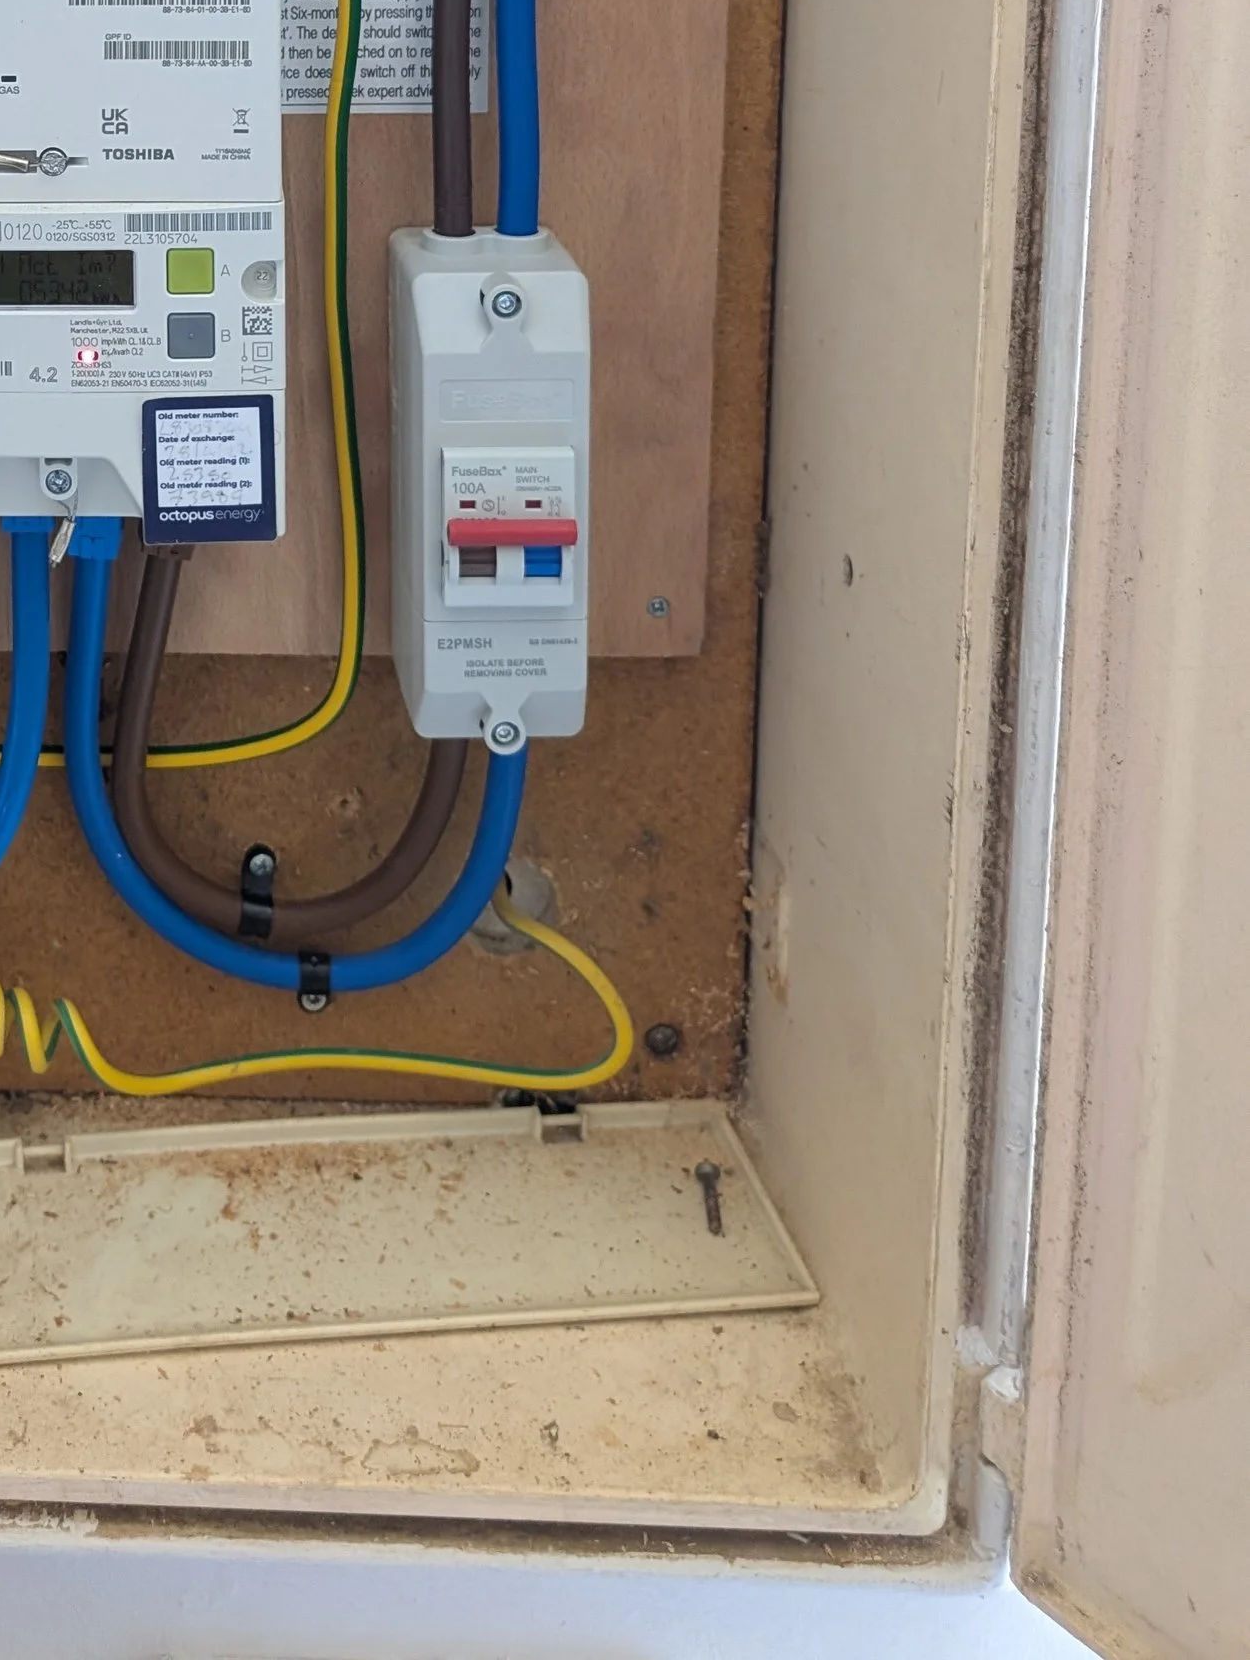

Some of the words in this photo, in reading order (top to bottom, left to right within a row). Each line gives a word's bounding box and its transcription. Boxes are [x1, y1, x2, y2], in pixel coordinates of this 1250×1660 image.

[374, 5, 423, 21] pressing
[297, 26, 317, 39] The
[364, 26, 400, 38] should
[289, 47, 313, 60] then
[305, 66, 332, 79] does
[360, 65, 395, 78] switch
[401, 65, 415, 77] off
[367, 86, 402, 100] expert
[102, 109, 128, 121] UK
[102, 122, 128, 135] CA
[103, 149, 174, 160] TOSHIBA
[4, 224, 42, 240] 0120
[125, 233, 198, 245] 22L3105704
[221, 265, 230, 276] A
[222, 330, 231, 342] B
[29, 367, 58, 382] 4.2
[181, 434, 189, 442] of
[516, 466, 537, 474] MAIN
[205, 481, 237, 489] reading
[516, 476, 550, 484] SWITCH
[453, 482, 486, 494] 100A
[159, 511, 214, 523] octopus
[215, 509, 260, 522] energy
[437, 638, 492, 650] E2PMSH
[466, 659, 503, 668] ISOLATE
[507, 658, 544, 667] BEFORE
[464, 668, 512, 677] REMOVING
[515, 668, 547, 676] COVER
